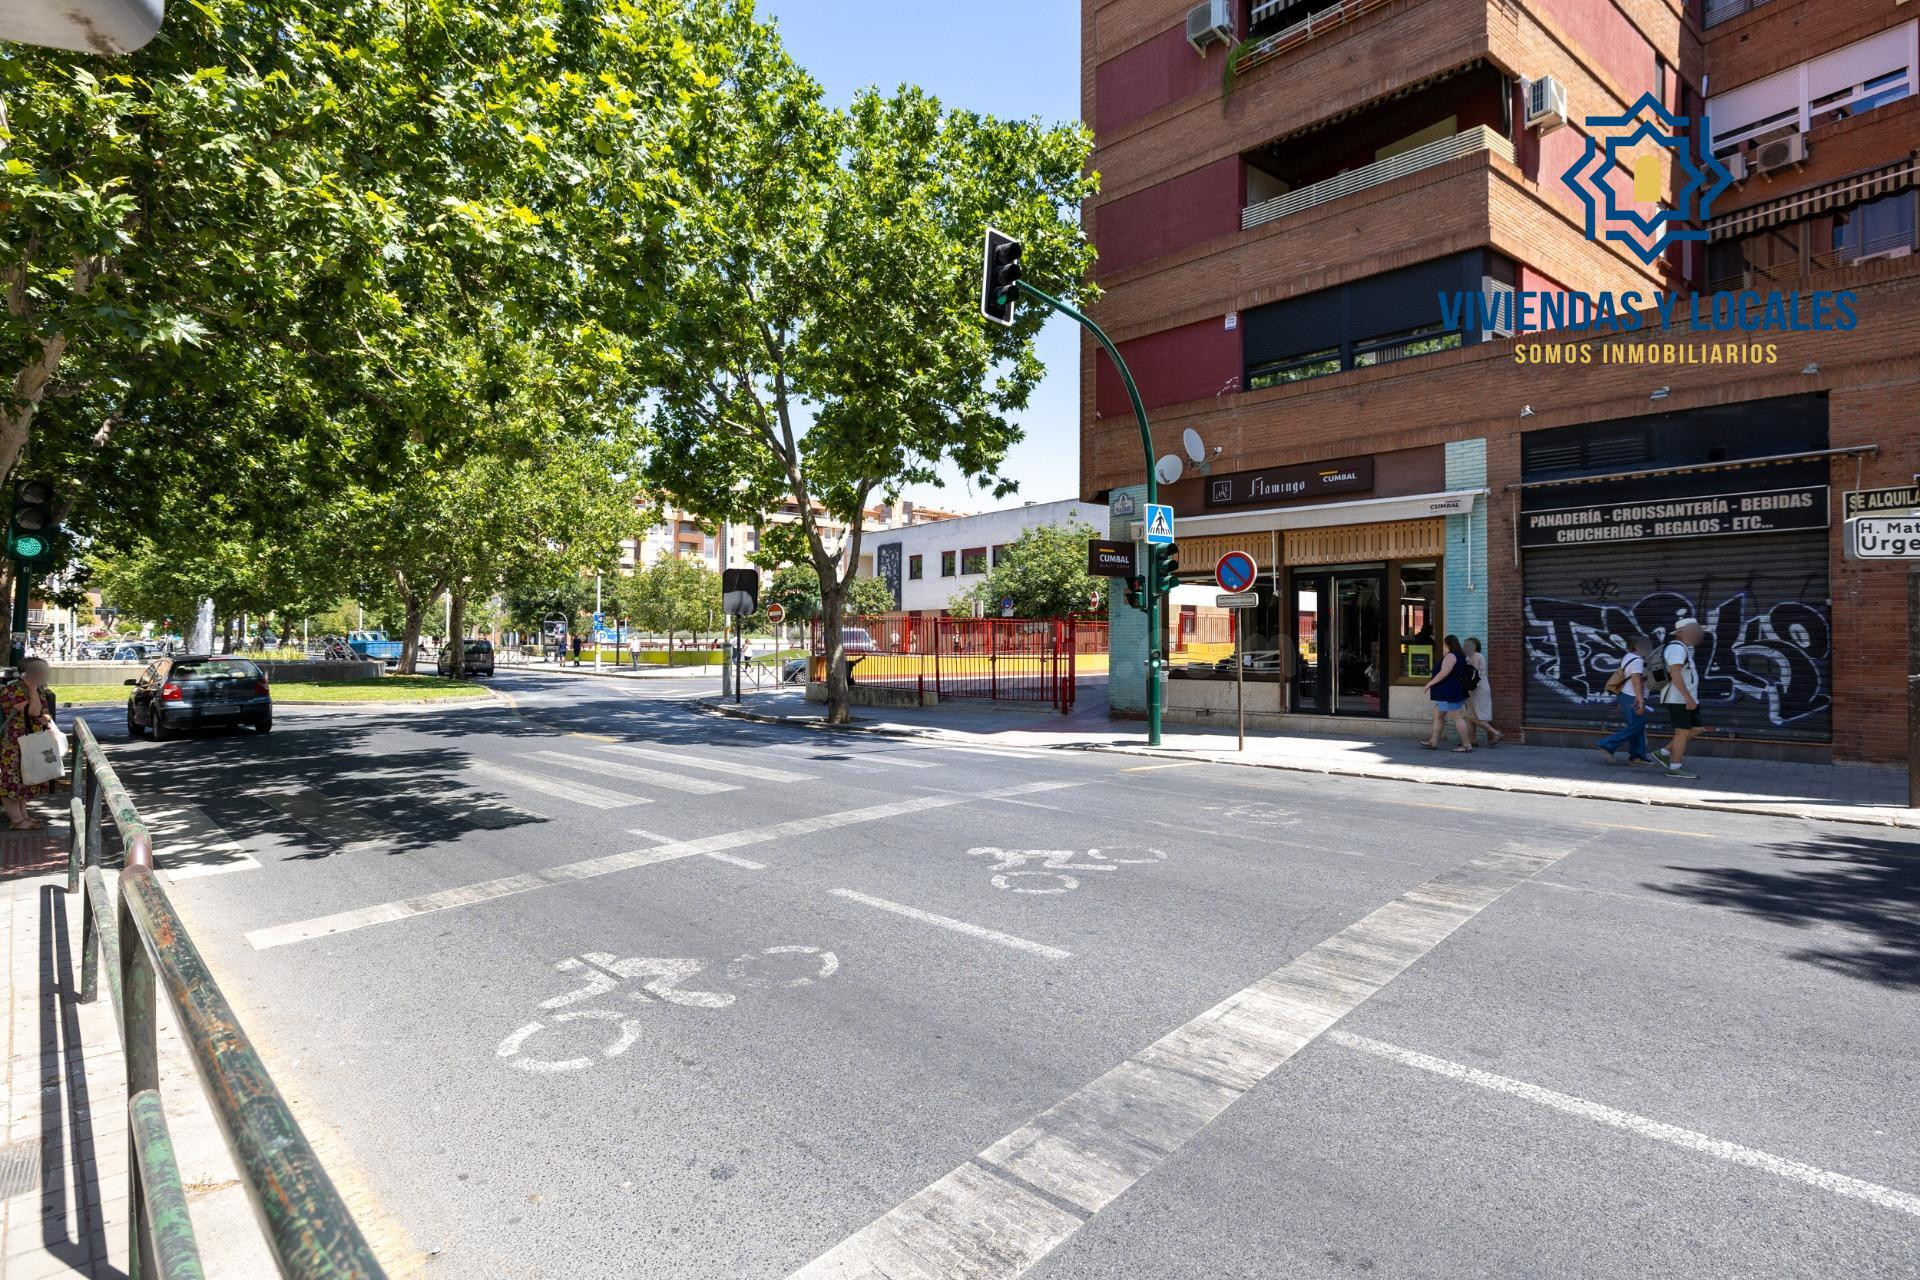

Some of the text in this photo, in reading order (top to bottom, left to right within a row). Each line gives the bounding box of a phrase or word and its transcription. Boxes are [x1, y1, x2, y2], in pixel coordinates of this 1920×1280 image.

[1323, 473, 1357, 483] CUMBAL
[1248, 477, 1305, 500] Flamingo
[1430, 502, 1460, 510] CUMBAL
[1849, 494, 1866, 509] SE
[1530, 492, 1813, 528] PANADERÍA CROISSANTERÍA BEBIDAS
[1556, 515, 1774, 542] CHUCHERÍAS REGALOS ETC...
[1861, 522, 1880, 534] H.
[1861, 535, 1920, 554] Urge
[1099, 554, 1130, 564] CUMBAL
